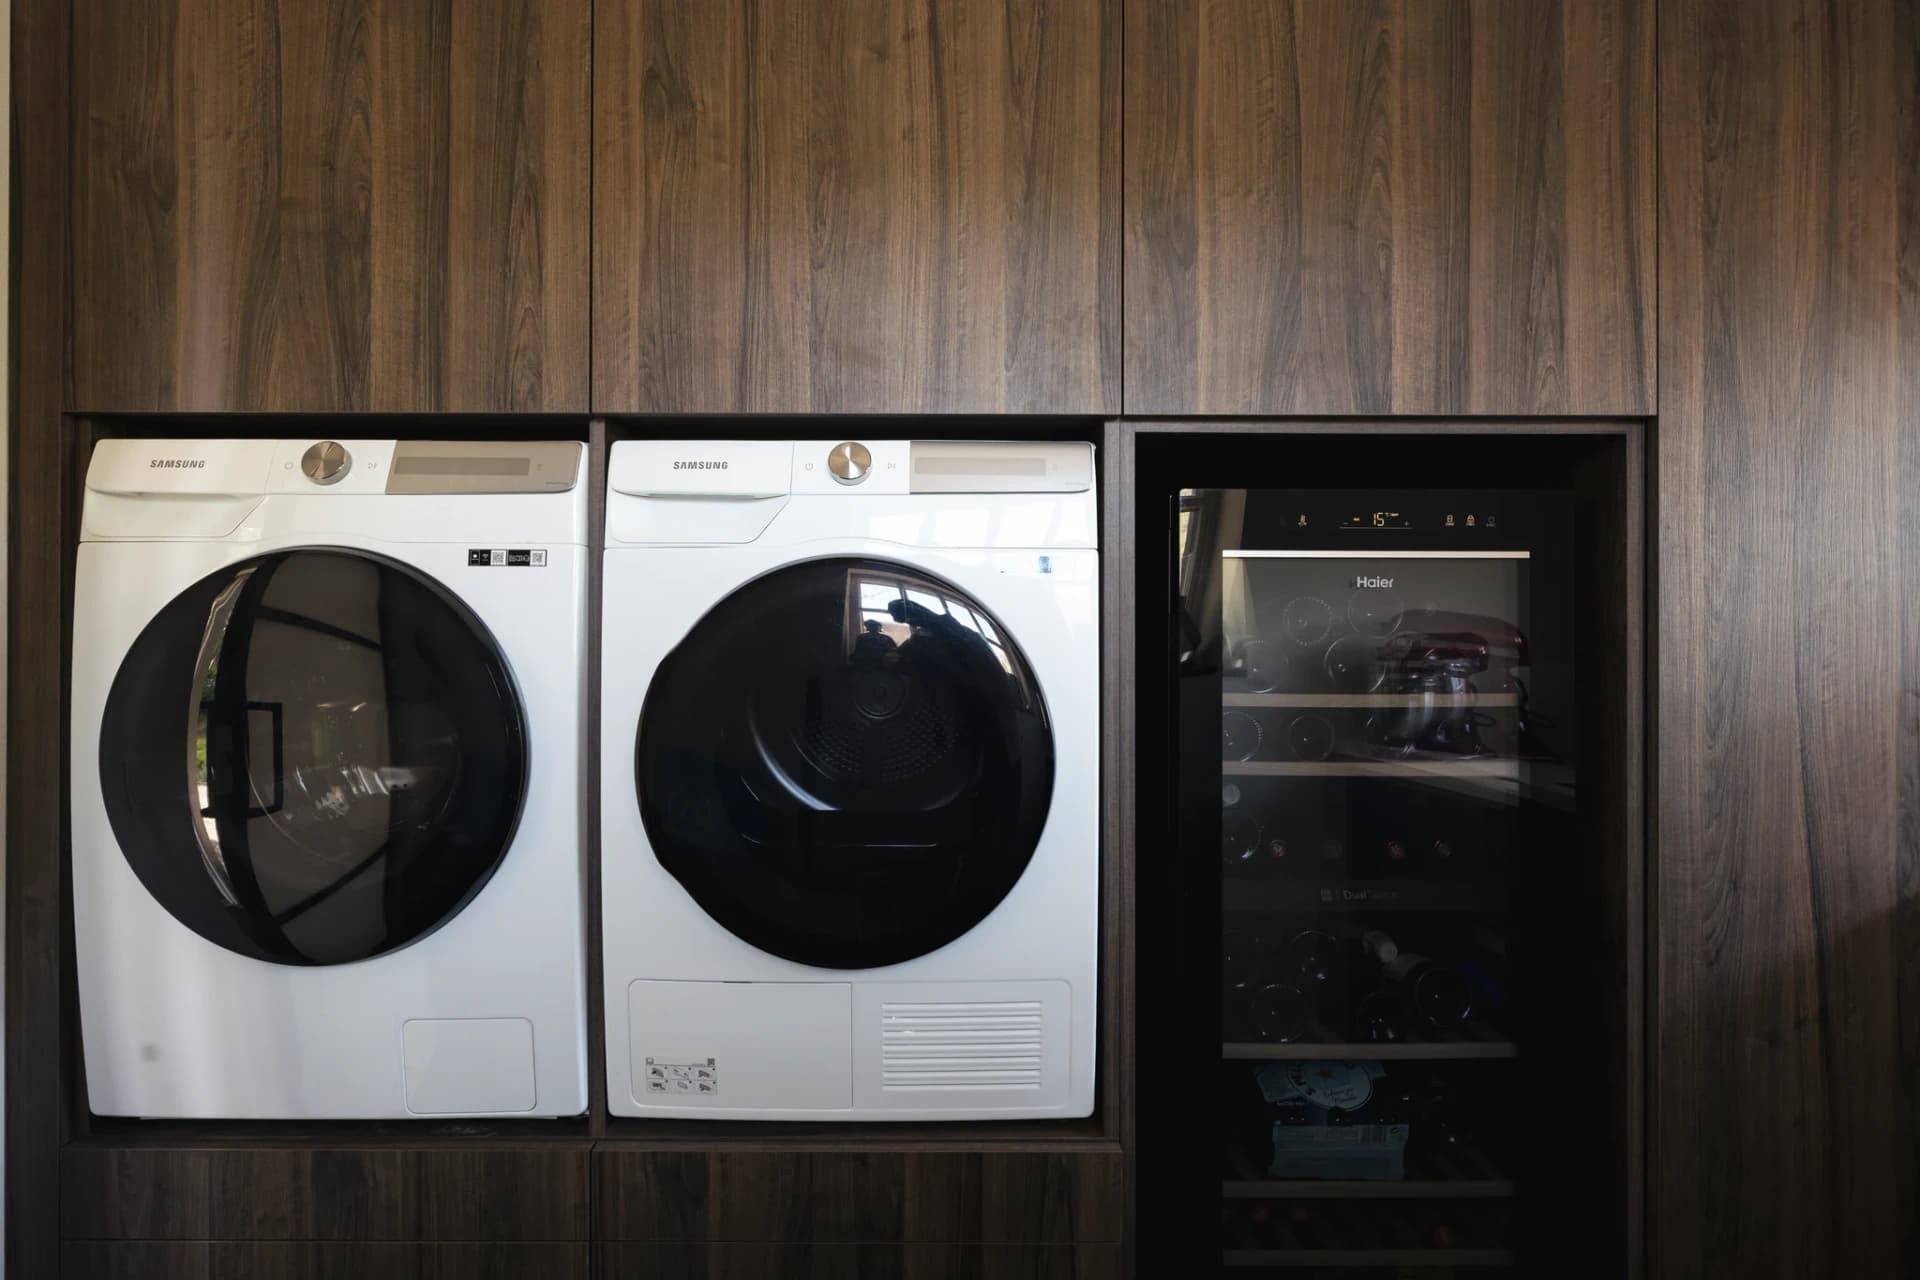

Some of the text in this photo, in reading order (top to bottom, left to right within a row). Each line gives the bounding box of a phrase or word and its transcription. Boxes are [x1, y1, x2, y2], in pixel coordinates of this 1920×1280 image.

[150, 459, 206, 469] SAMSUNG
[673, 461, 728, 470] SAMSUNG
[1356, 575, 1394, 588] Haier
